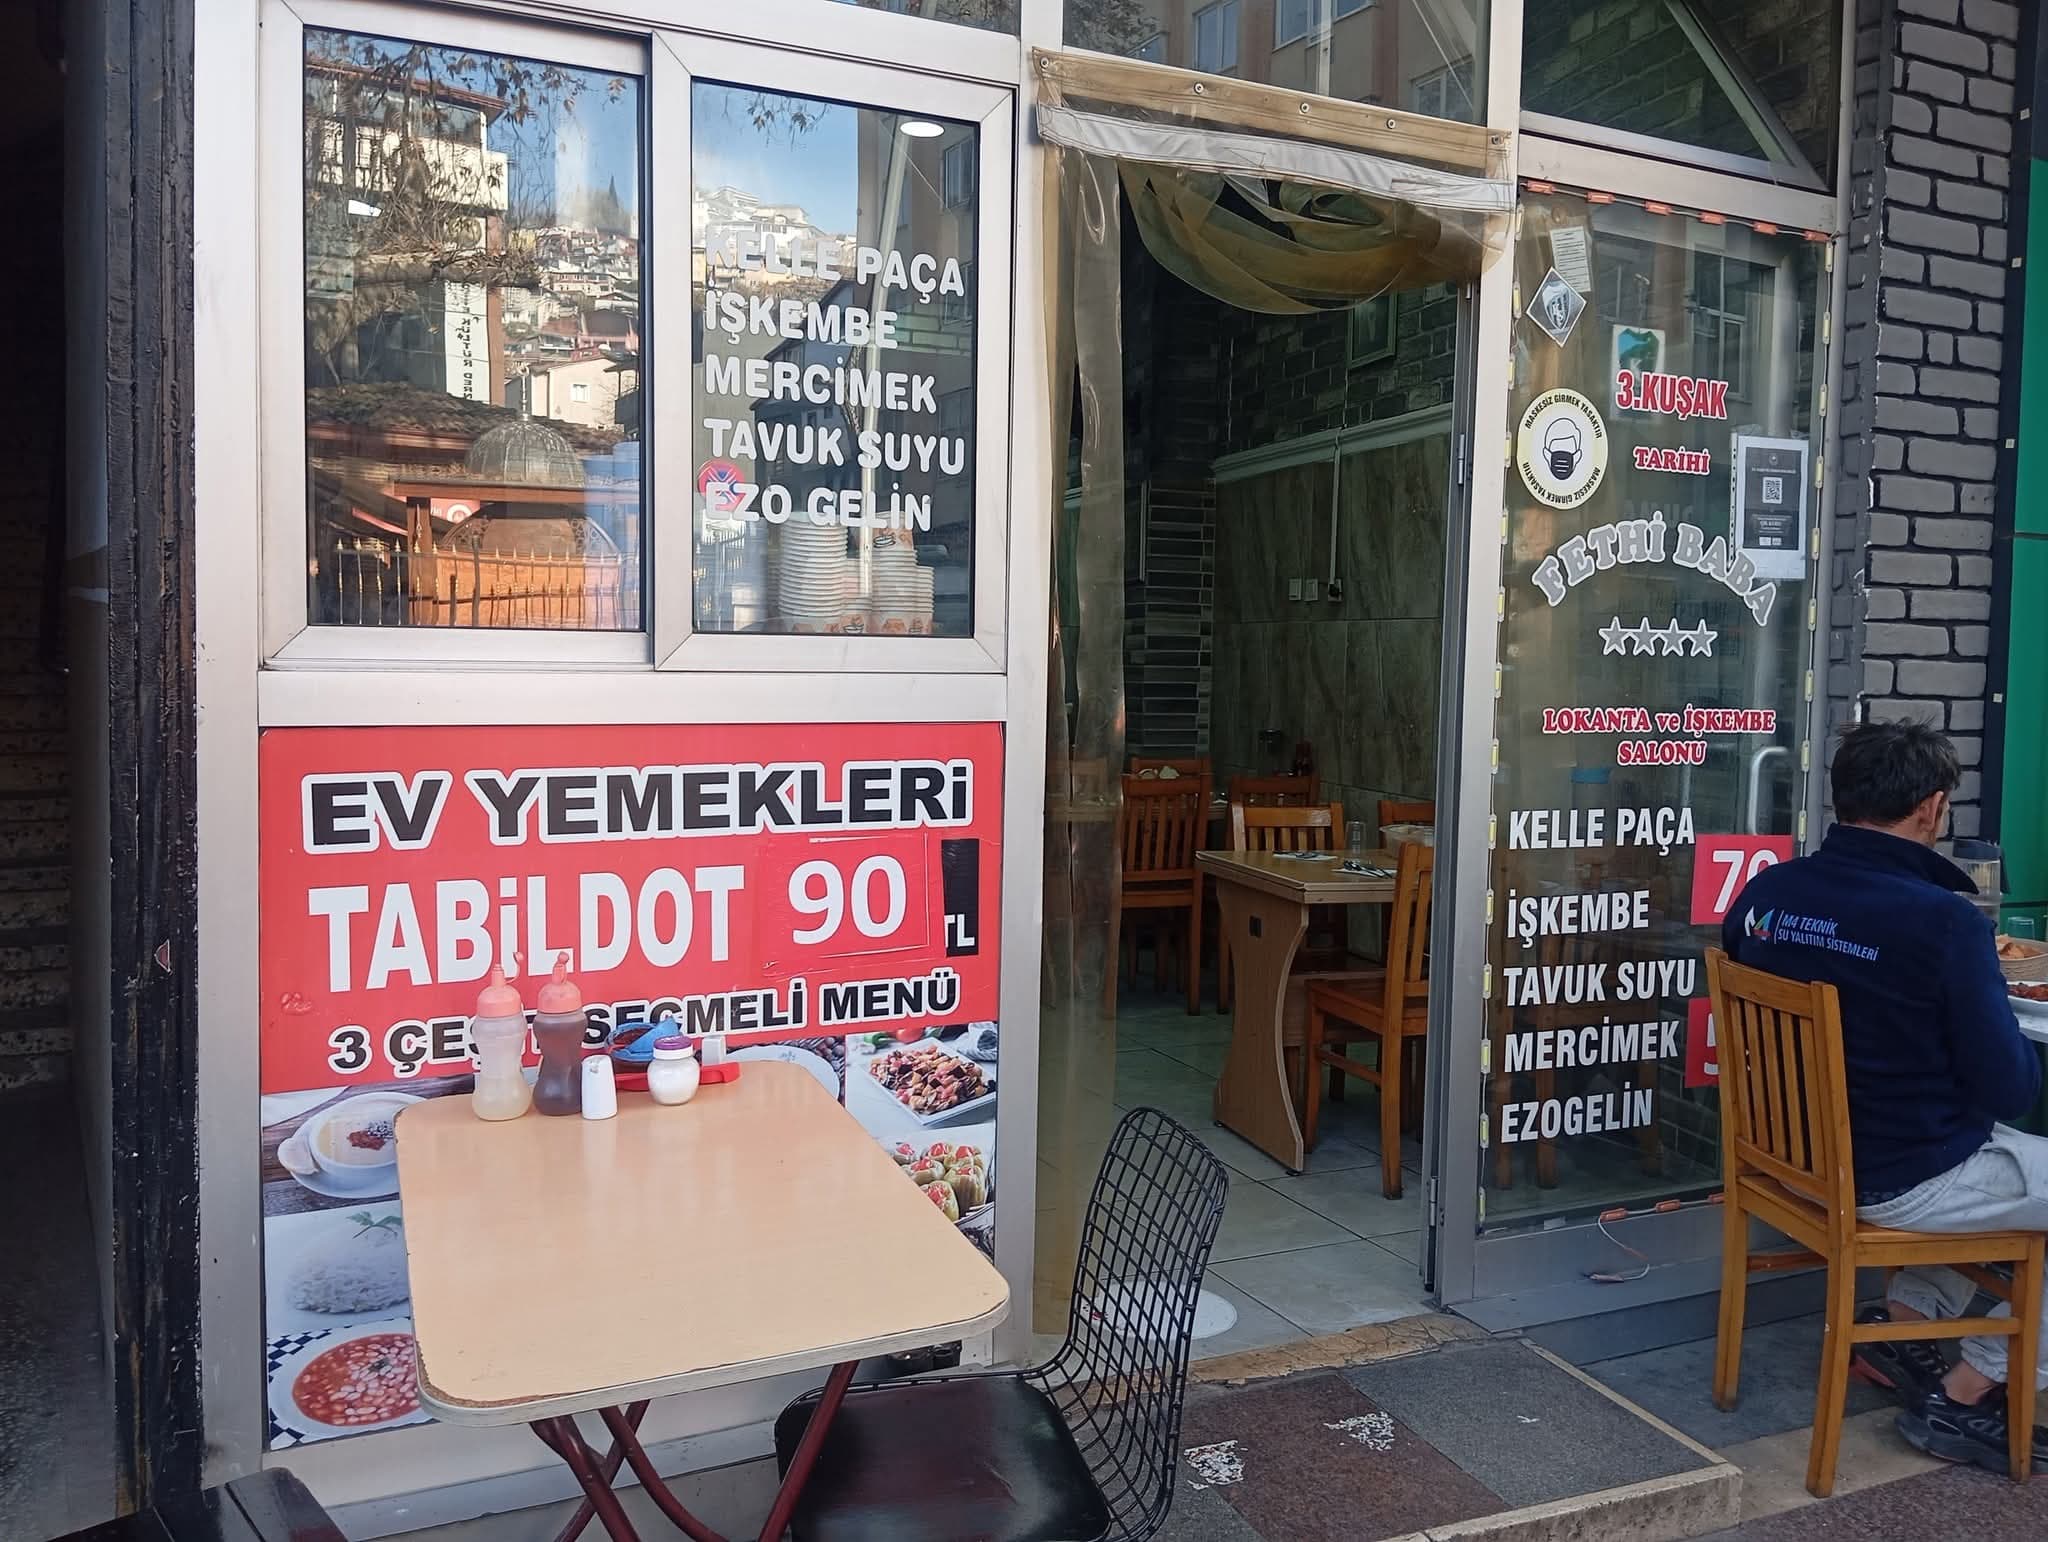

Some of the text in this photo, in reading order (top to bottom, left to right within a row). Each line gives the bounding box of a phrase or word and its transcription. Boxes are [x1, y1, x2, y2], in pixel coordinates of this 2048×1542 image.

[705, 224, 964, 304] KELLE PAÇA
[705, 279, 898, 349] İŞKEMBE
[705, 354, 936, 413] MERCİMEK
[1616, 370, 1728, 420] 3.KUŞAK
[1525, 394, 1602, 439] MASKESİZ GİRMEK YASAKTIR
[703, 418, 964, 475] TAVUK SUYU
[1632, 444, 1711, 476] TARİHİ
[705, 482, 931, 531] EZO GELİN
[1531, 510, 1776, 626] FETHİ BABA
[1543, 703, 1775, 738] LOKANTA ve İŞKEMBE
[1617, 740, 1707, 766] SALONU
[302, 770, 452, 854] EV
[1509, 807, 1696, 857] KELLE PAÇA
[786, 855, 906, 945] 90
[1507, 889, 1650, 949] İŞKEMBE
[1778, 929, 1789, 941] SU
[1790, 931, 1825, 948] YALITIM
[1503, 959, 1696, 1007] TAVUK SUYU
[328, 1025, 372, 1075] 3
[820, 968, 960, 1026] MENÜ
[1504, 1016, 1679, 1073] MERCİMEK
[1500, 1082, 1653, 1143] EZOGELİN
